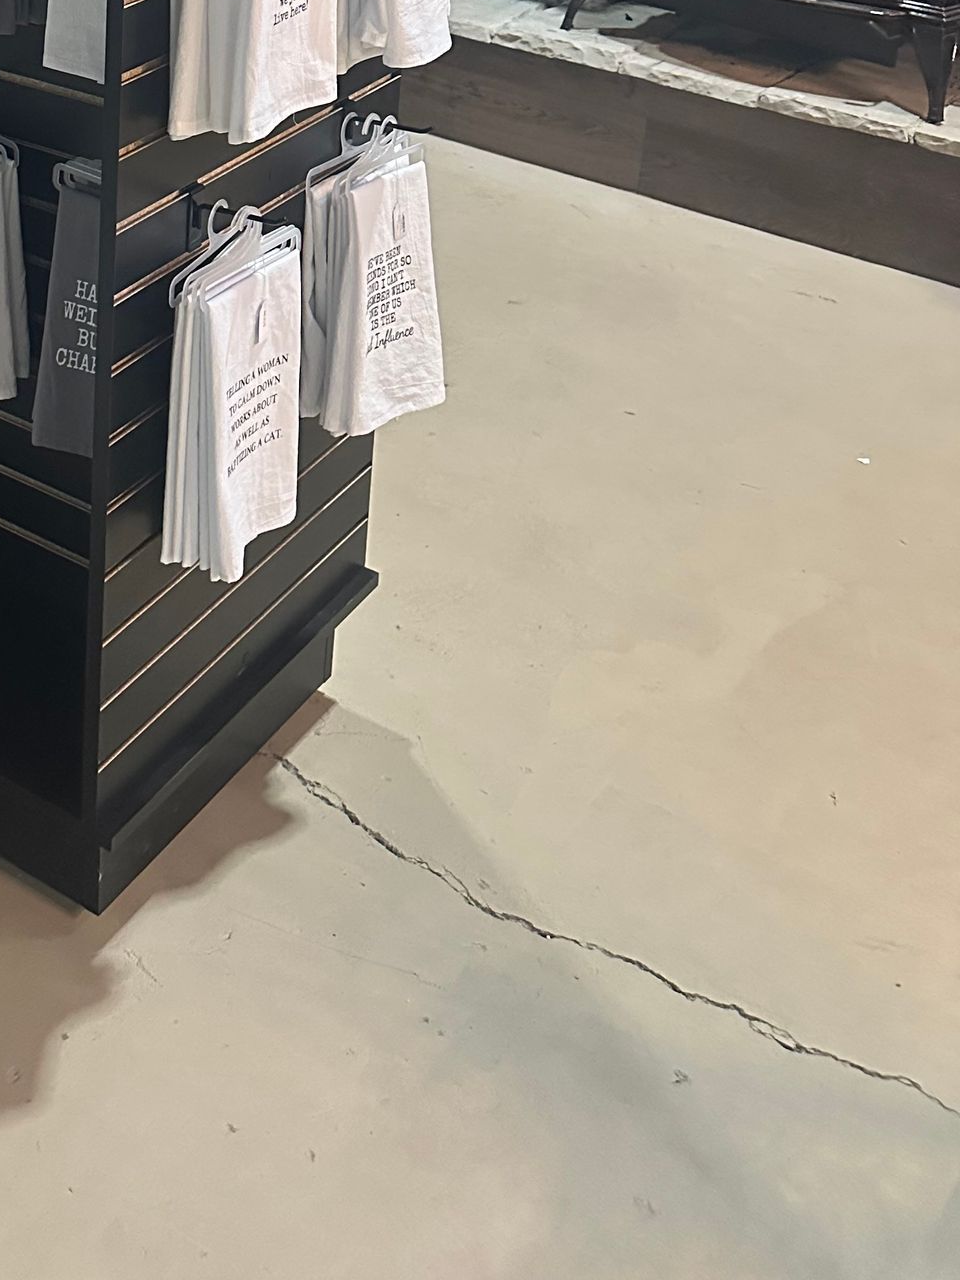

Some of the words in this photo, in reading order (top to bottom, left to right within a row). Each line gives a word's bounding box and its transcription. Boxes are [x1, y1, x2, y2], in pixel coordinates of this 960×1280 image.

[385, 245, 401, 261] BEEN
[387, 258, 399, 274] FOR
[400, 255, 412, 266] SO
[381, 279, 386, 290] I
[386, 269, 405, 287] CAN'T
[391, 279, 416, 297] WHICH
[380, 301, 390, 314] OF
[392, 297, 402, 309] US
[371, 319, 379, 331] IS
[381, 311, 397, 327] THE
[374, 326, 414, 350] Influence
[226, 373, 251, 400] TELLING
[257, 353, 290, 377] WOMAN
[229, 403, 238, 417] TO
[237, 389, 256, 410] CALM
[256, 374, 281, 396] DOWN
[231, 409, 251, 433] WORKS
[251, 393, 278, 417] ABOUT
[234, 435, 242, 450] AS
[241, 421, 260, 440] WELL
[260, 415, 270, 428] AS
[227, 445, 257, 478] BAPTIZING
[257, 438, 263, 447] A
